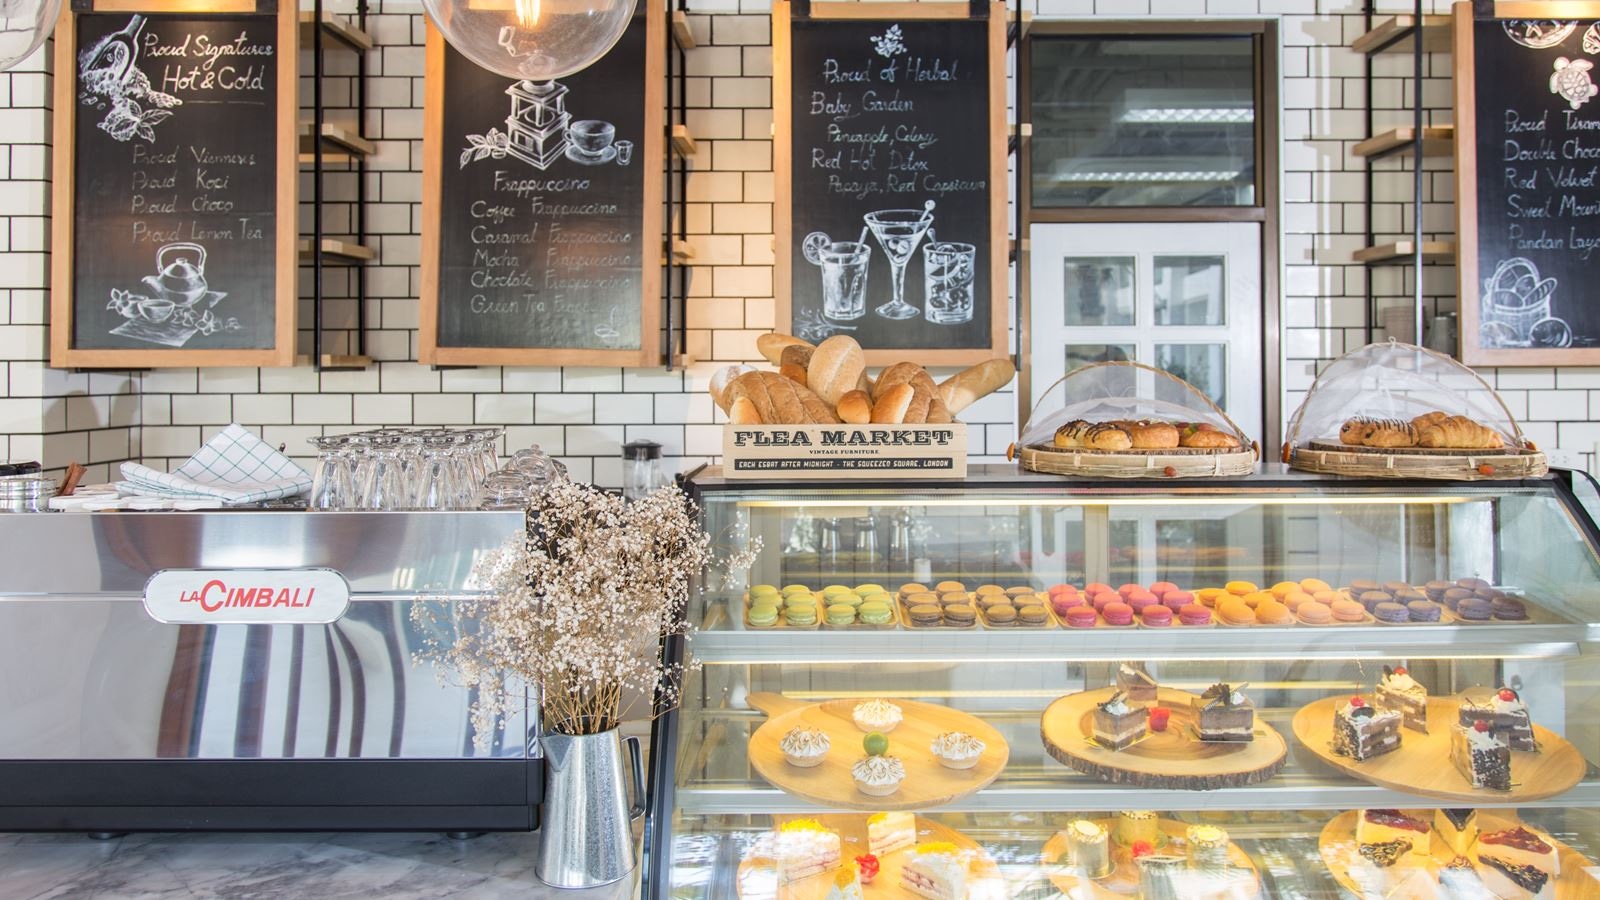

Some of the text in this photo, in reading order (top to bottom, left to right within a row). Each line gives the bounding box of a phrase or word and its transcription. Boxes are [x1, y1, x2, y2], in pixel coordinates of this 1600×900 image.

[144, 31, 274, 70] Proud Signatures
[162, 64, 265, 92] Hot & Cold
[823, 56, 958, 84] Proud of Herbal
[810, 89, 914, 122] Baby Garden
[1504, 109, 1548, 132] Proud
[132, 144, 180, 165] Proud
[811, 148, 929, 171] Red Hot Detox
[1504, 138, 1557, 161] Double
[131, 168, 230, 192] Proud Kopi
[494, 170, 590, 198] Frappuccino
[887, 172, 918, 193] Red
[1505, 166, 1598, 190] Red Velvet
[131, 194, 234, 214] Proud Choco
[470, 196, 618, 224] Coffee Frappuccino
[1507, 194, 1551, 217] Sweet
[132, 217, 263, 243] Proud Lemon Tea
[1508, 223, 1563, 250] Pandan
[473, 249, 520, 267] Mocha
[470, 294, 519, 313] Green
[734, 430, 953, 446] FLEA MARKET
[803, 460, 834, 468] MIDNIGHT
[843, 460, 855, 468] THE
[923, 460, 949, 468] LONDON
[200, 579, 316, 612] CIMBALI
